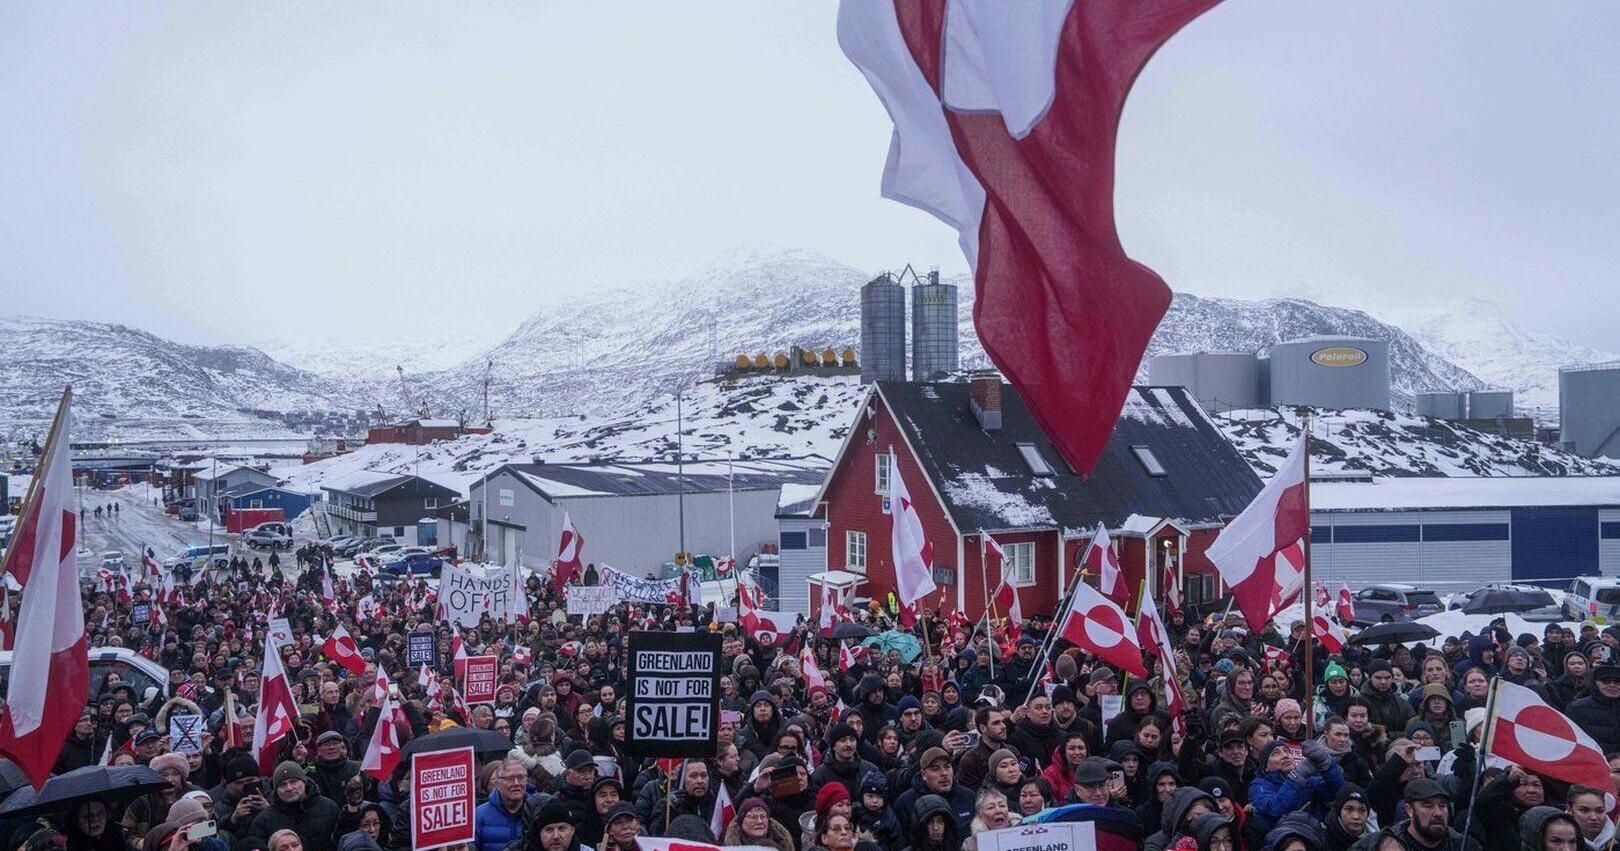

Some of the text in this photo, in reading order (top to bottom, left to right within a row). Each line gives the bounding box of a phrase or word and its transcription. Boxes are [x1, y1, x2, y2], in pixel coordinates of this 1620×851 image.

[451, 573, 510, 591] HANDS
[640, 653, 711, 670] GREENLAND
[637, 680, 709, 695] IS NOT FOR
[636, 706, 708, 737] SALE!
[422, 766, 466, 783] GREENLAND
[422, 783, 466, 801] IS NOT FOR
[423, 801, 467, 831] SALE!
[1006, 843, 1068, 851] ENLAND
